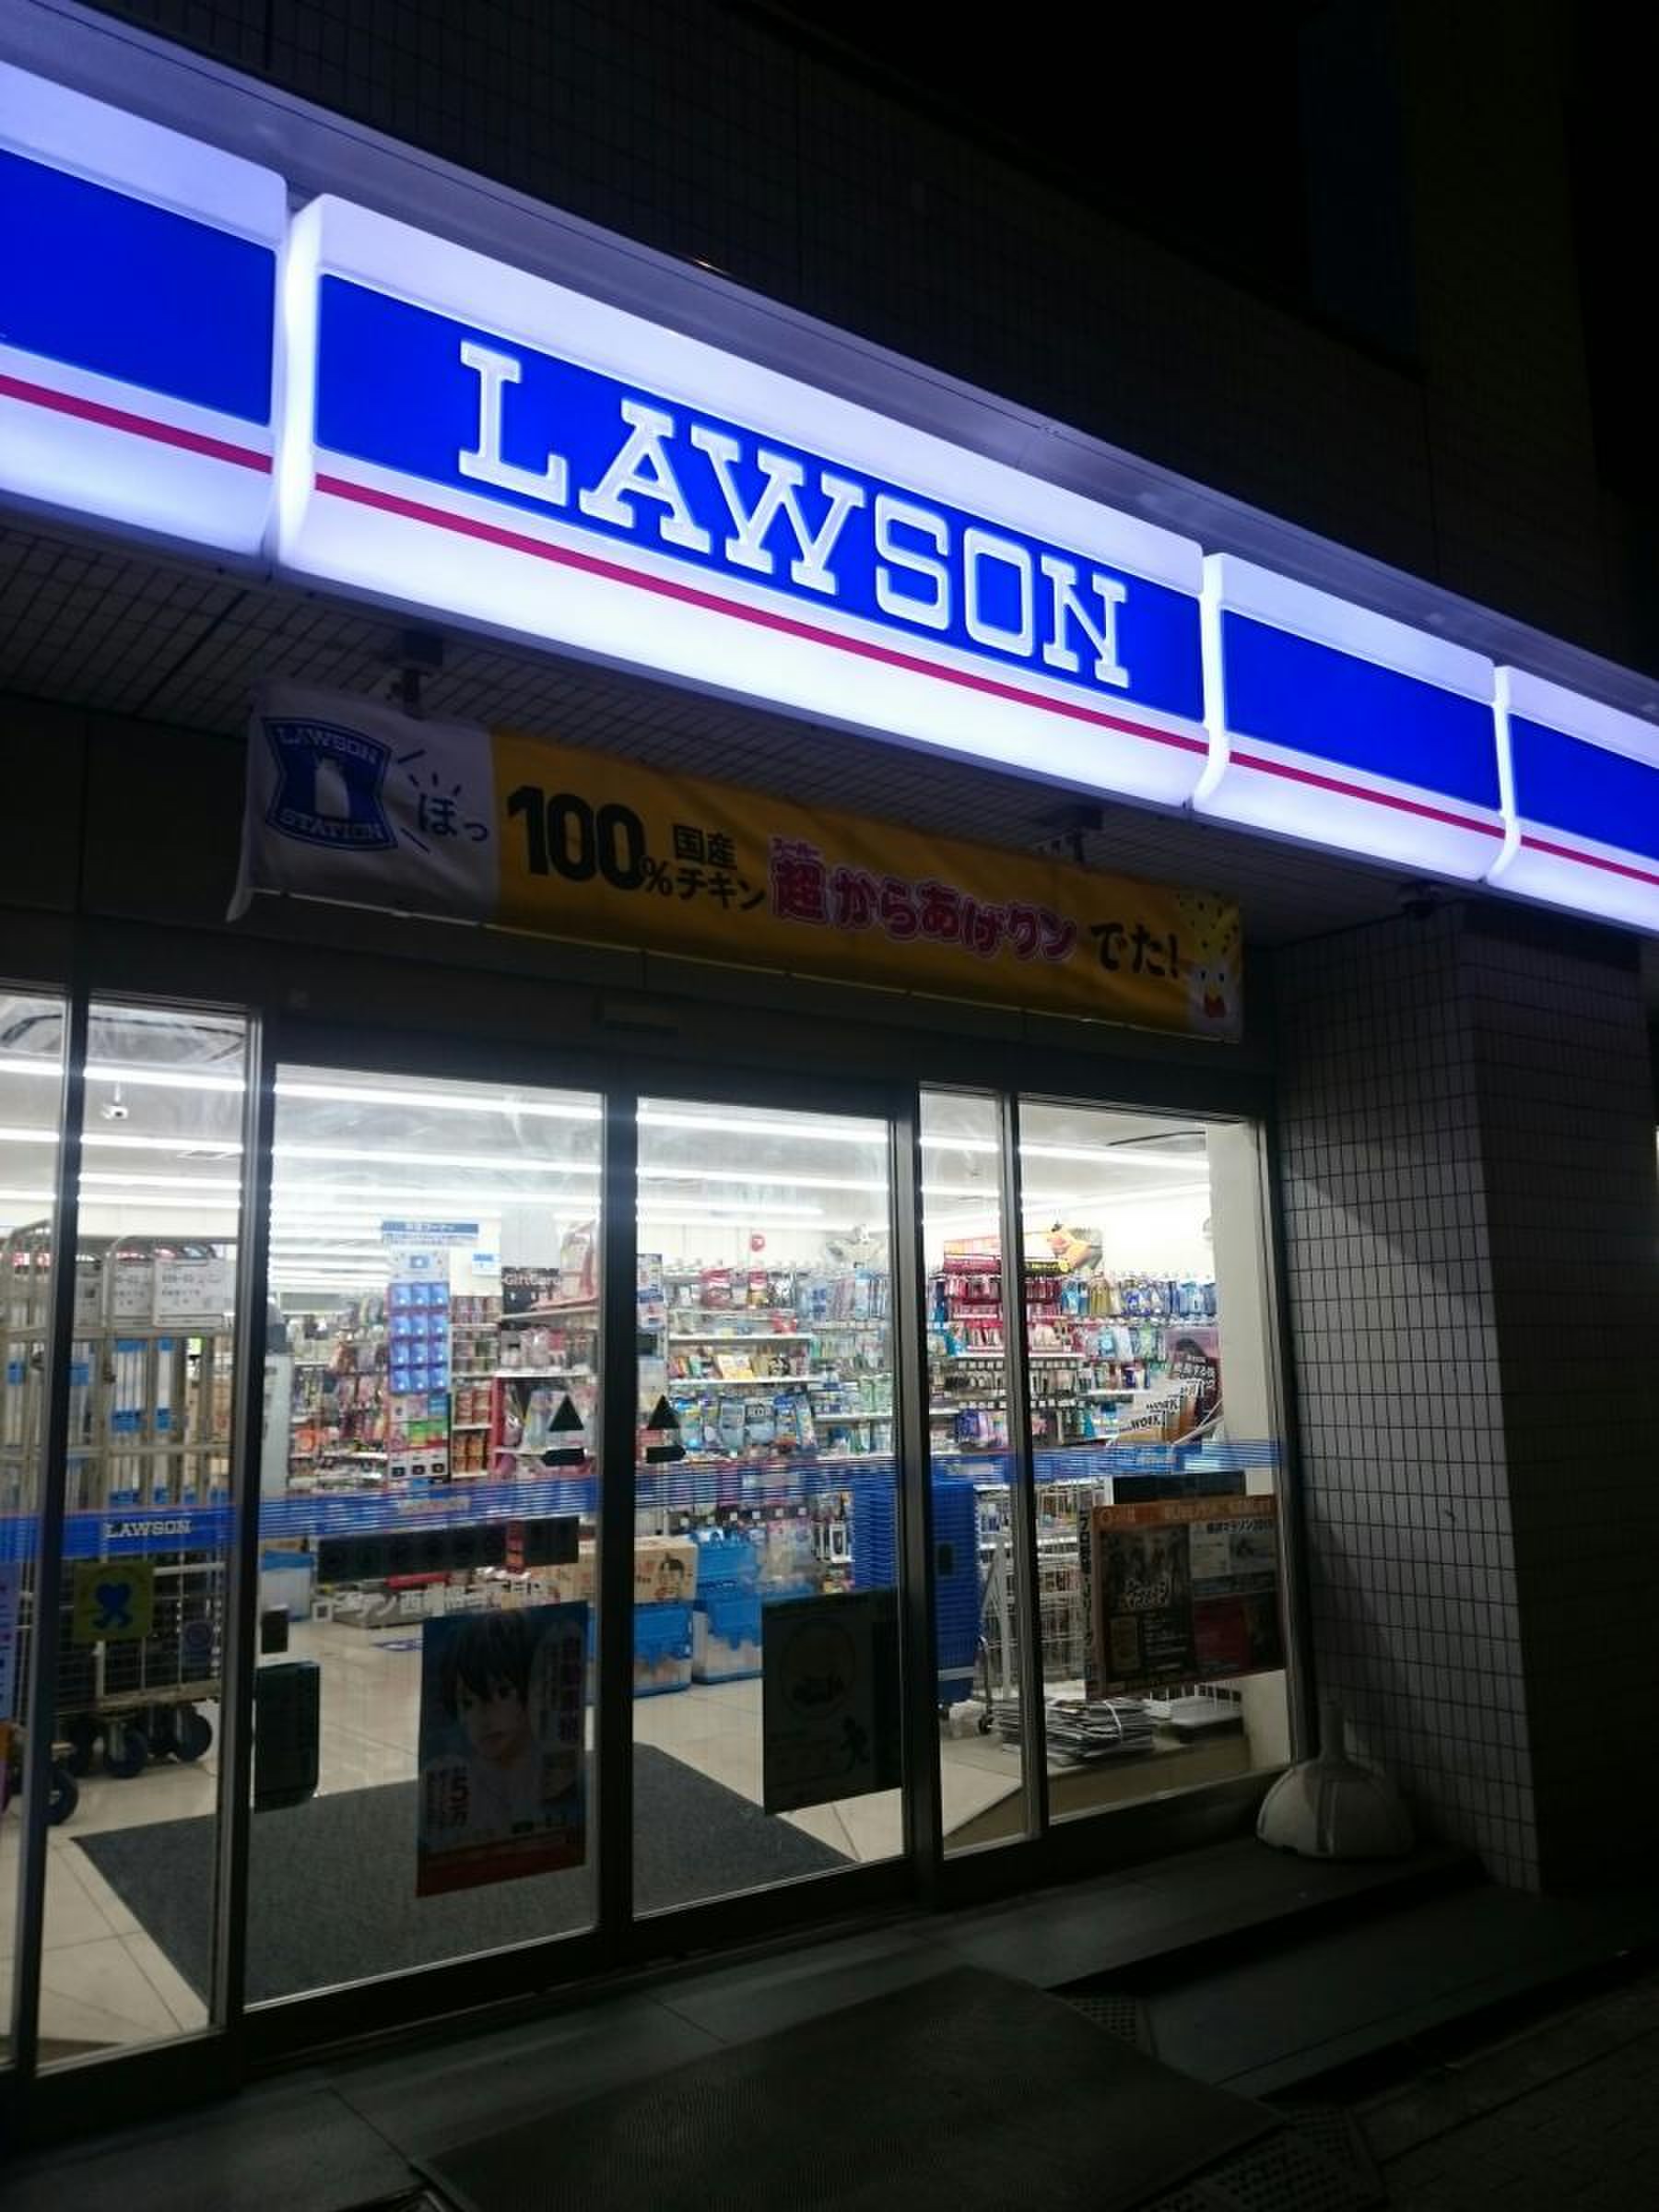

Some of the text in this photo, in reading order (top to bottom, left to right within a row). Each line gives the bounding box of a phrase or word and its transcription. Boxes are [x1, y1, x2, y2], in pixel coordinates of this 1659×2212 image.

[459, 342, 1129, 688] LAWSON
[276, 724, 381, 766] LAWSON
[279, 807, 383, 841] STATION
[673, 823, 738, 871] 国産
[677, 866, 766, 911] チキン
[102, 1517, 193, 1538] LAWSON
